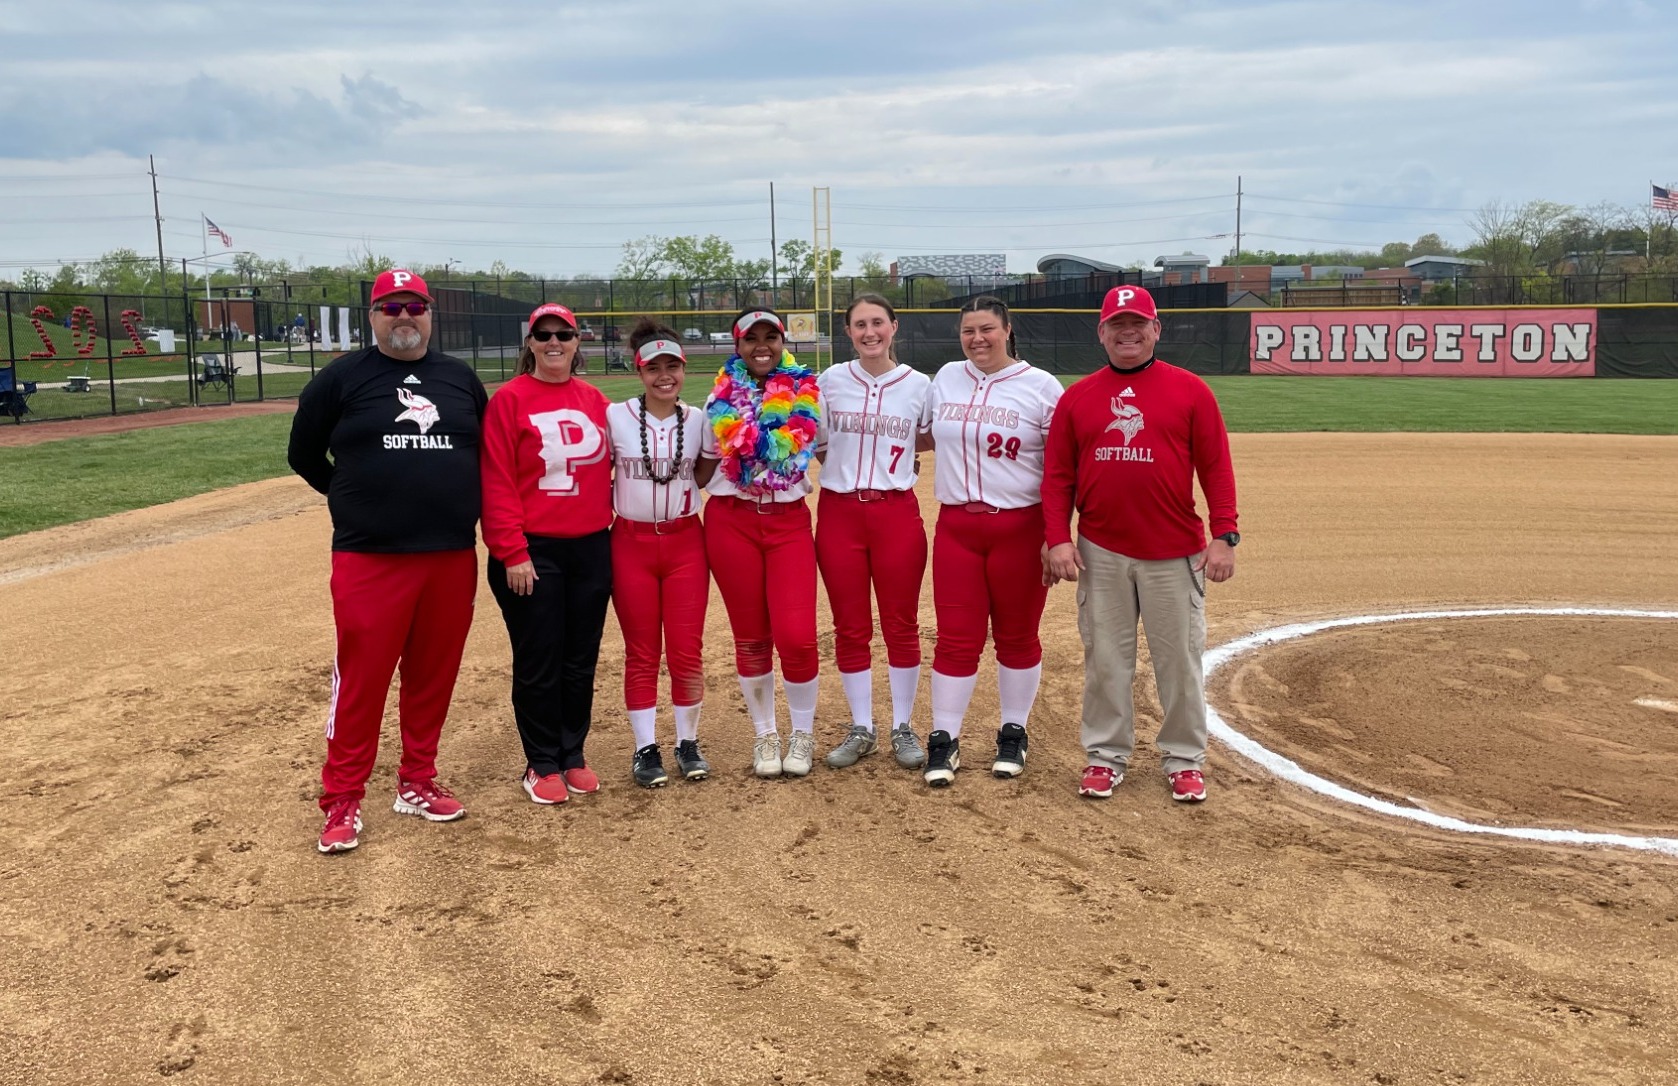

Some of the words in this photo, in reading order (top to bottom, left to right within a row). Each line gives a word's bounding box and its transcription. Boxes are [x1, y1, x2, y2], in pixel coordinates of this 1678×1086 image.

[393, 271, 411, 287] P
[1117, 290, 1135, 306] P
[656, 340, 665, 349] P
[1254, 323, 1593, 362] PRINCETON
[831, 410, 912, 441] VIKINGS
[937, 402, 1020, 430] VIKINGS
[382, 434, 453, 449] SOFTBALL
[528, 408, 606, 496] P
[986, 432, 1021, 461] 29
[1094, 446, 1154, 463] SOFTBALL
[888, 445, 905, 474] 7
[680, 488, 692, 516] 1
